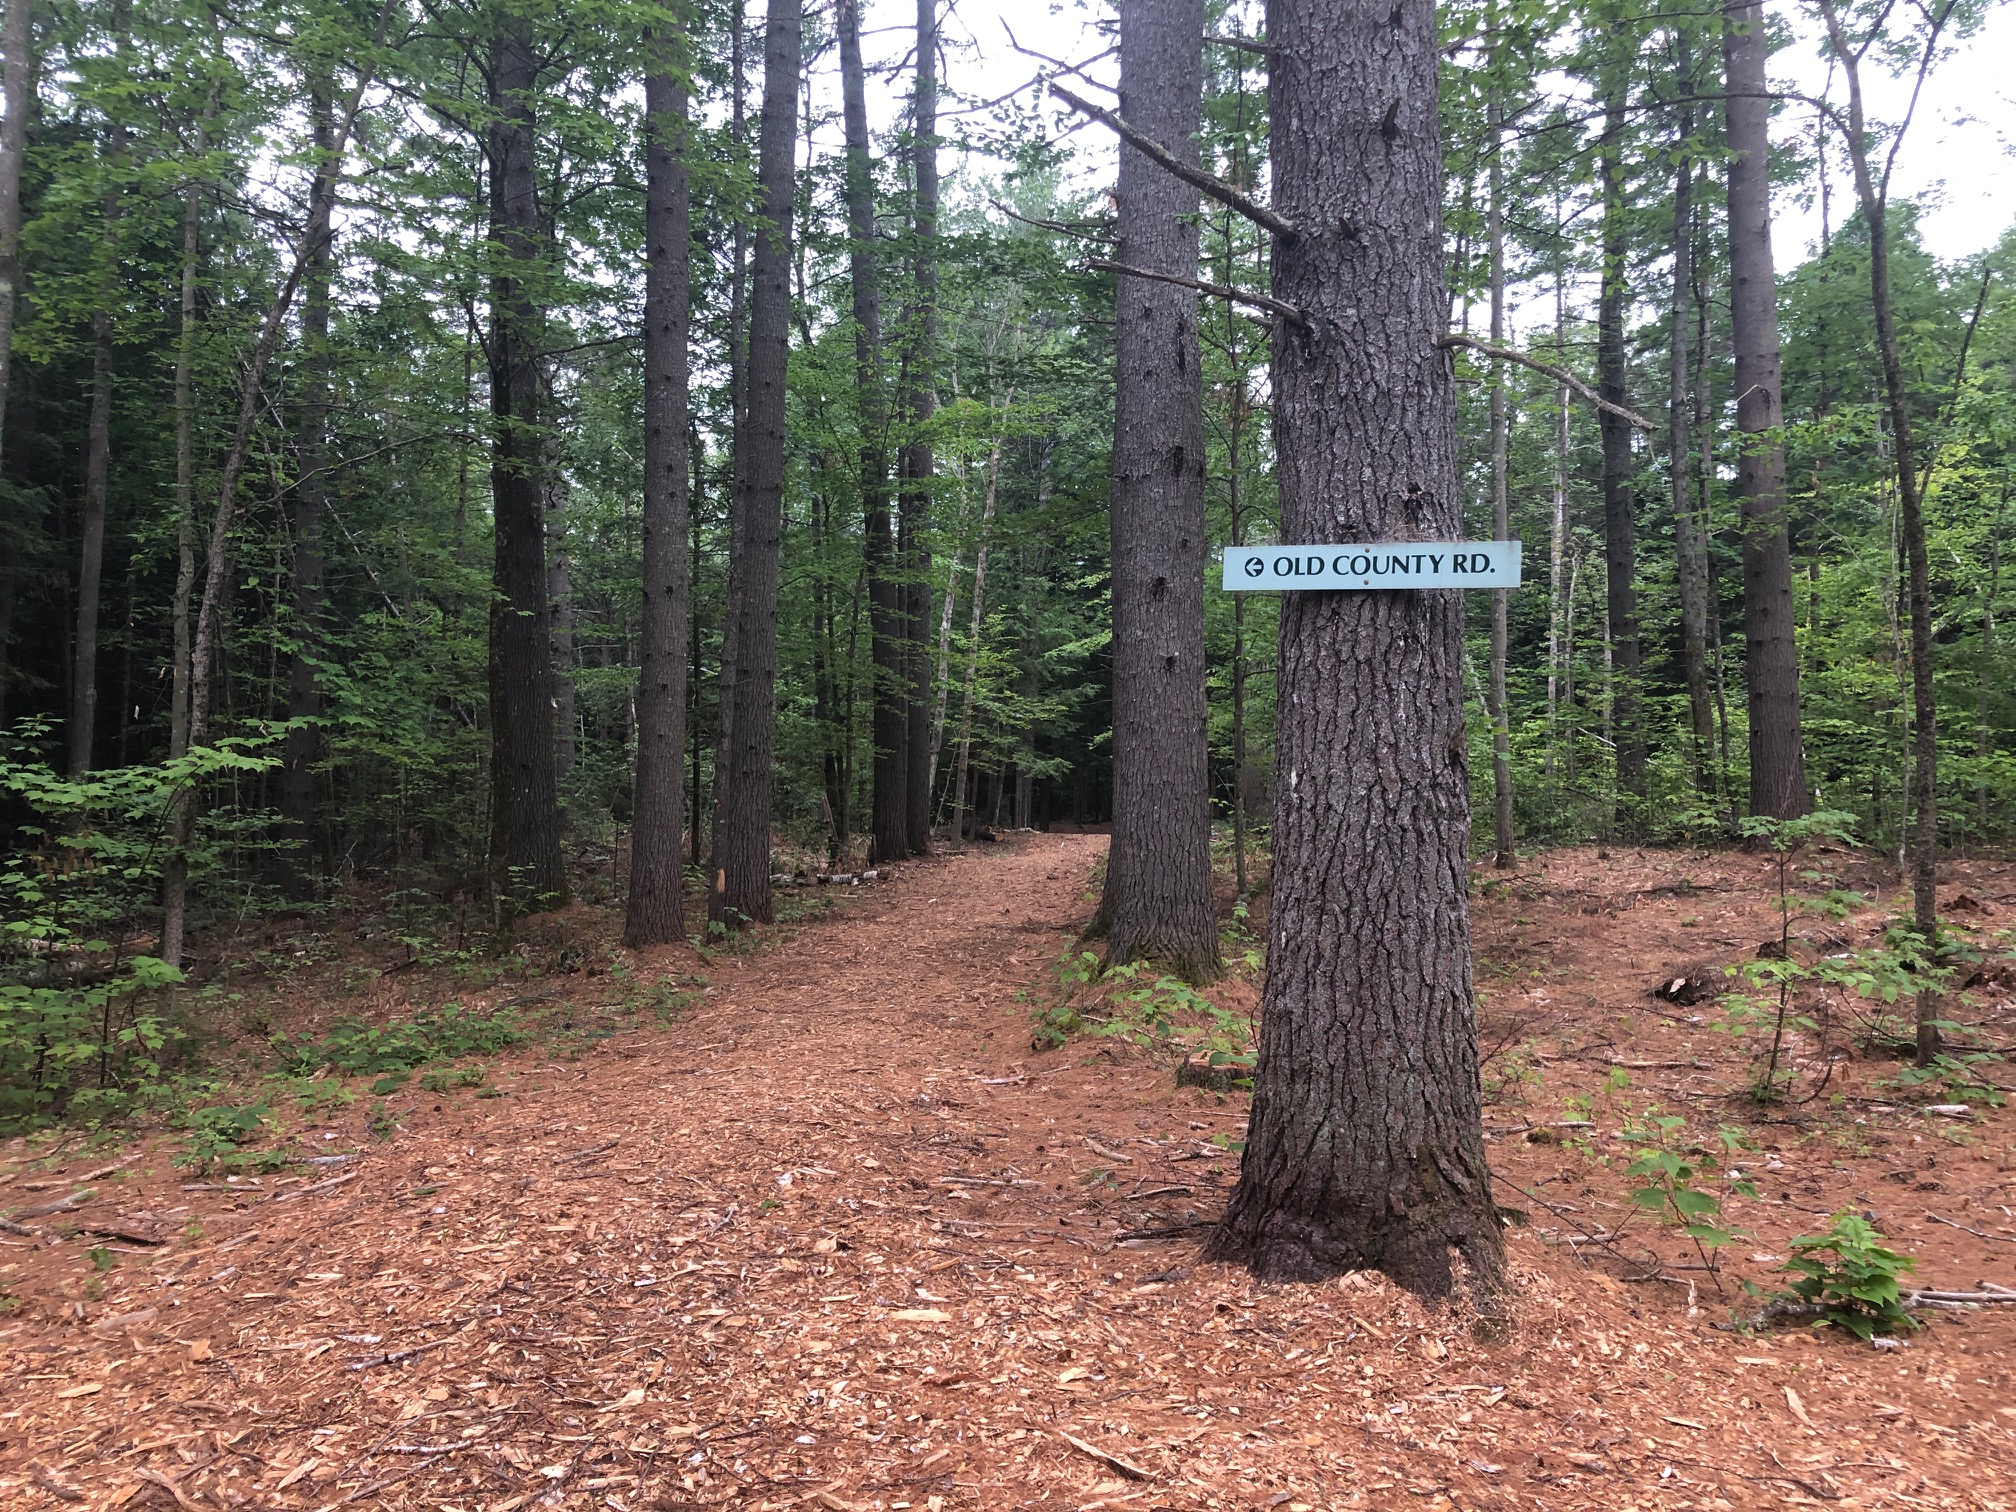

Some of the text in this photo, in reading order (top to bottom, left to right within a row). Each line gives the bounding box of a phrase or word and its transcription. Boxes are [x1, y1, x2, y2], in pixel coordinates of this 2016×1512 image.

[1273, 553, 1496, 577] OLD COUNTY RD.
